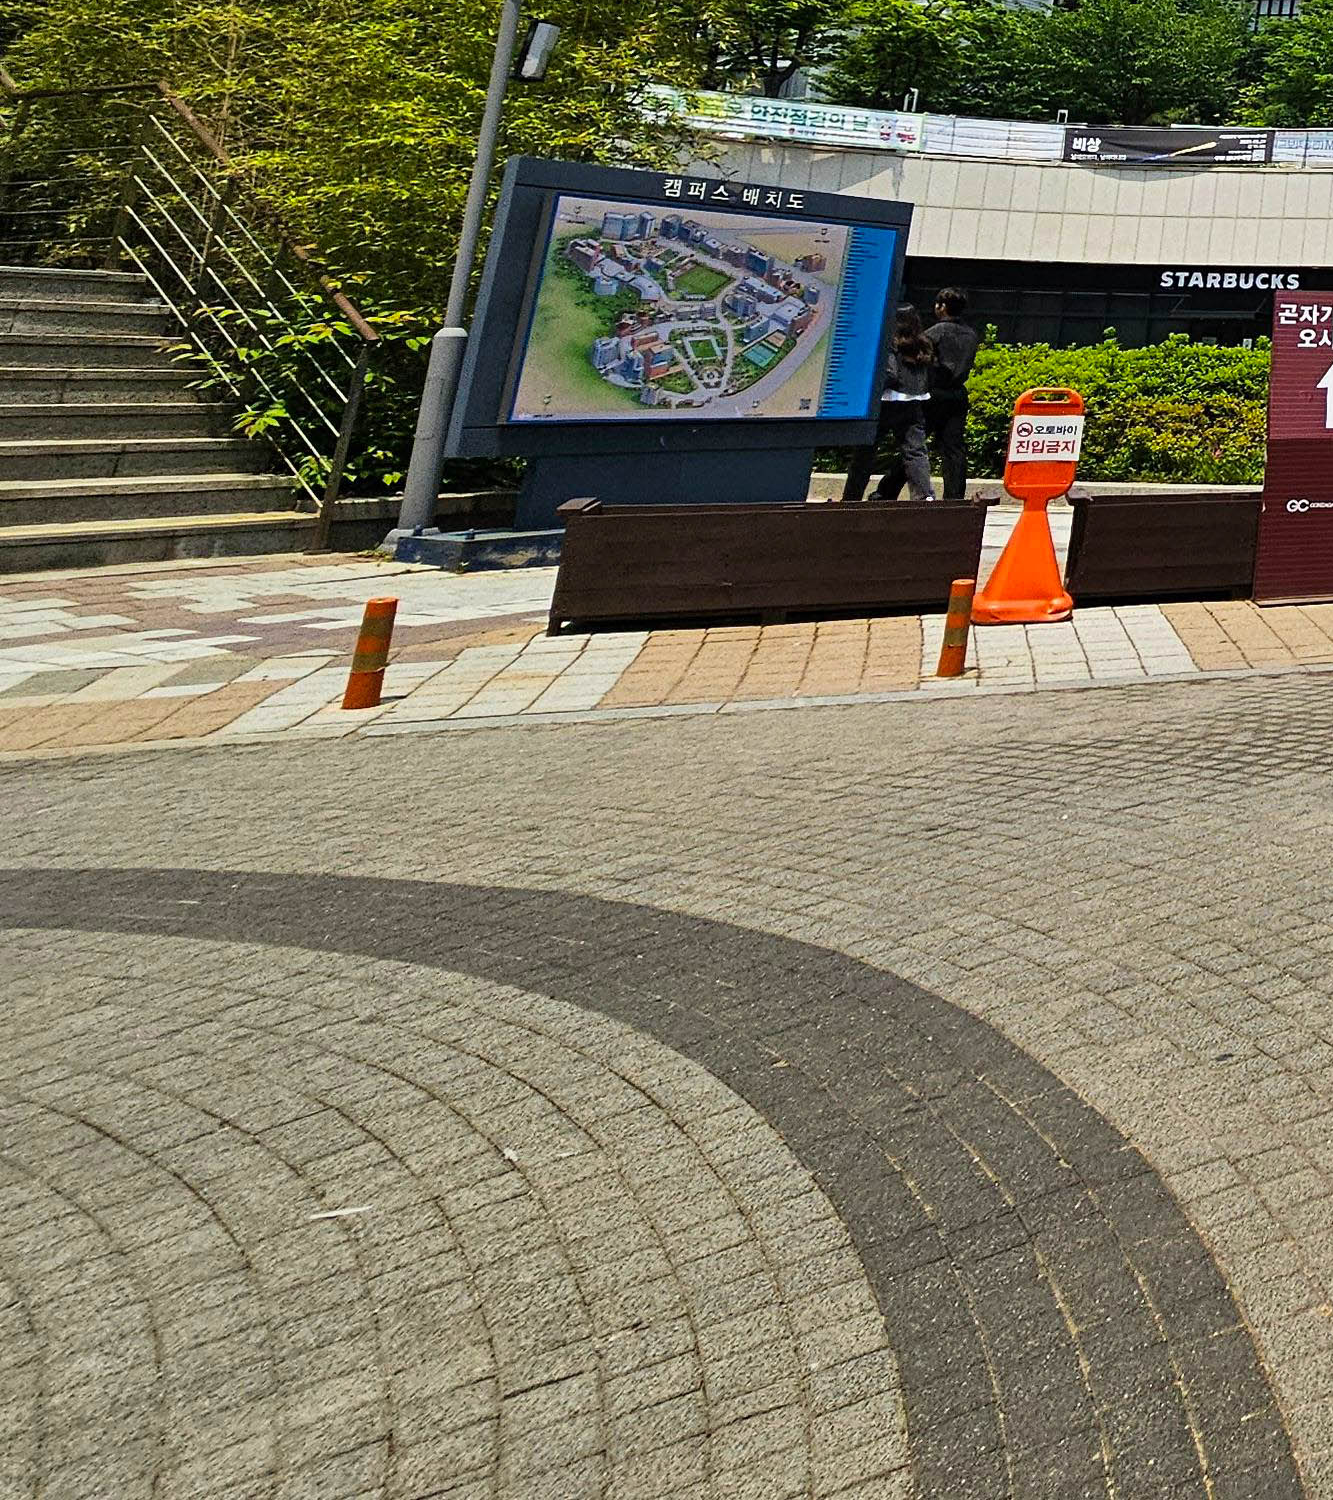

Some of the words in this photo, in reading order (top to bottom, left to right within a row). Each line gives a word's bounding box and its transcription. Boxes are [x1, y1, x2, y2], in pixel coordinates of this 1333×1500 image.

[1072, 137, 1102, 153] 비상
[663, 178, 730, 201] 캠퍼스
[742, 188, 805, 210] 배치도
[1160, 271, 1300, 290] STARBUCKS
[1034, 425, 1078, 435] 오토바이
[1016, 440, 1076, 454] 진입금지
[1286, 499, 1310, 512] GC
